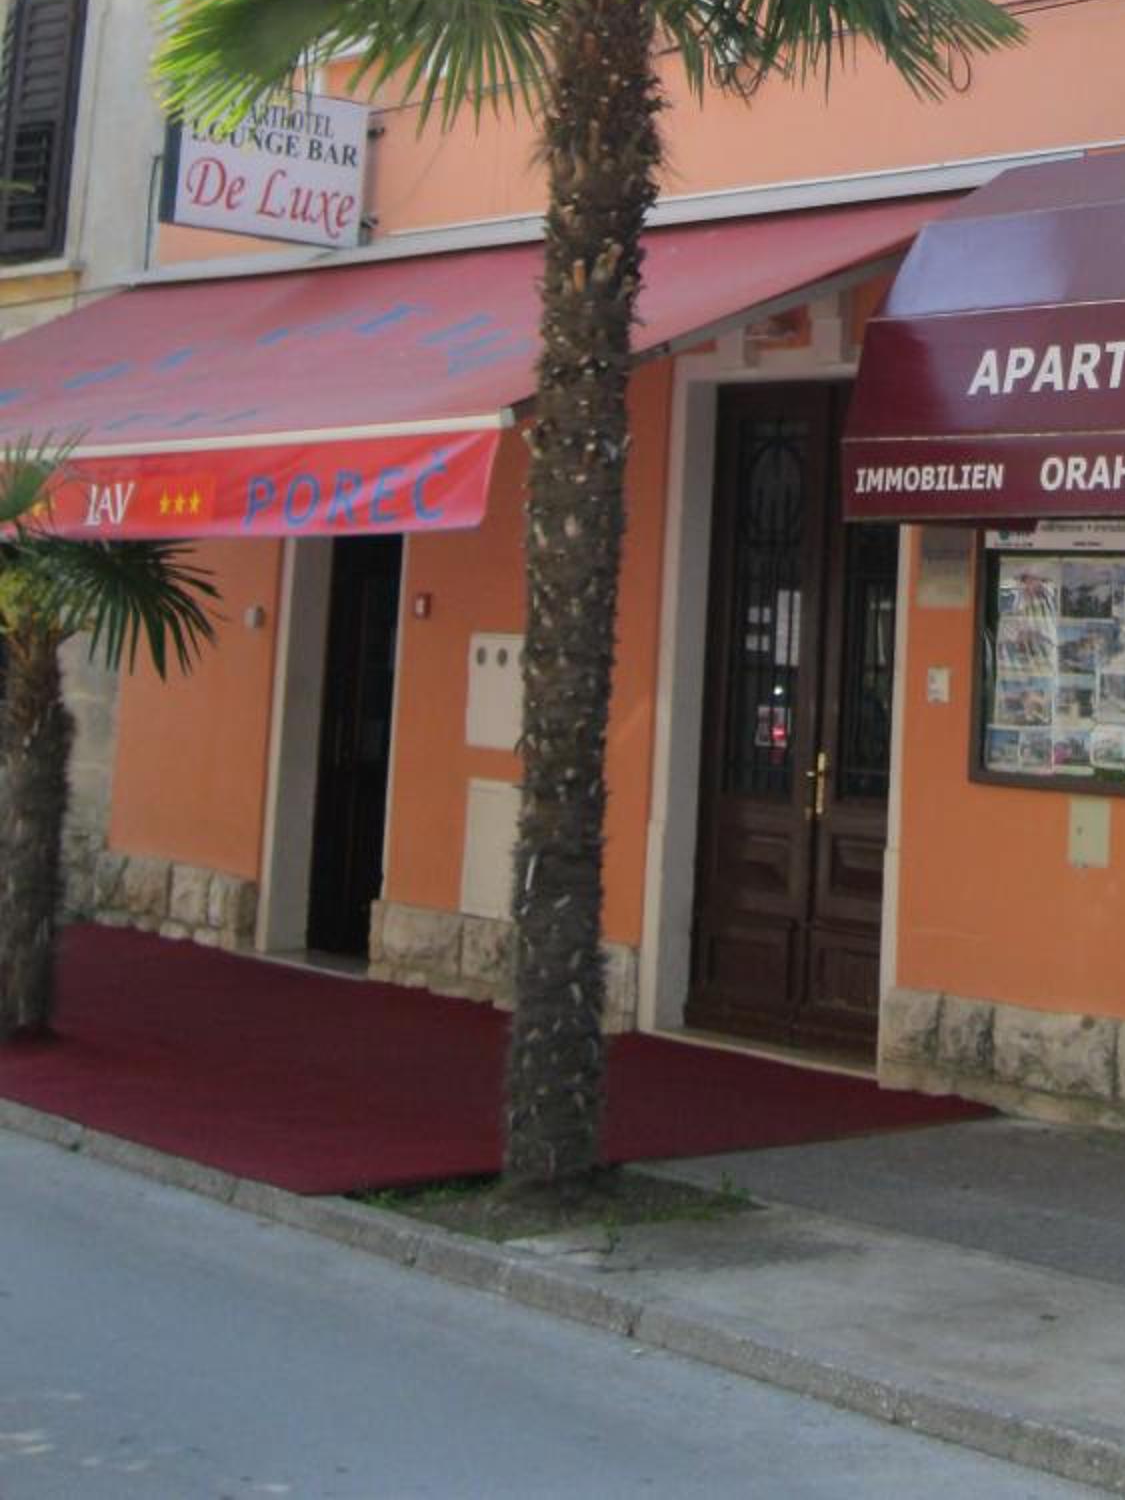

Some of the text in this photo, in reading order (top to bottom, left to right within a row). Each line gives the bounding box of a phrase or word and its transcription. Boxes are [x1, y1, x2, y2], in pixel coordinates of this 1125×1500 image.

[307, 138, 358, 168] BAR
[186, 157, 356, 239] De Luxe
[855, 463, 1005, 494] IMMOBILIEN
[84, 480, 135, 527] LAV
